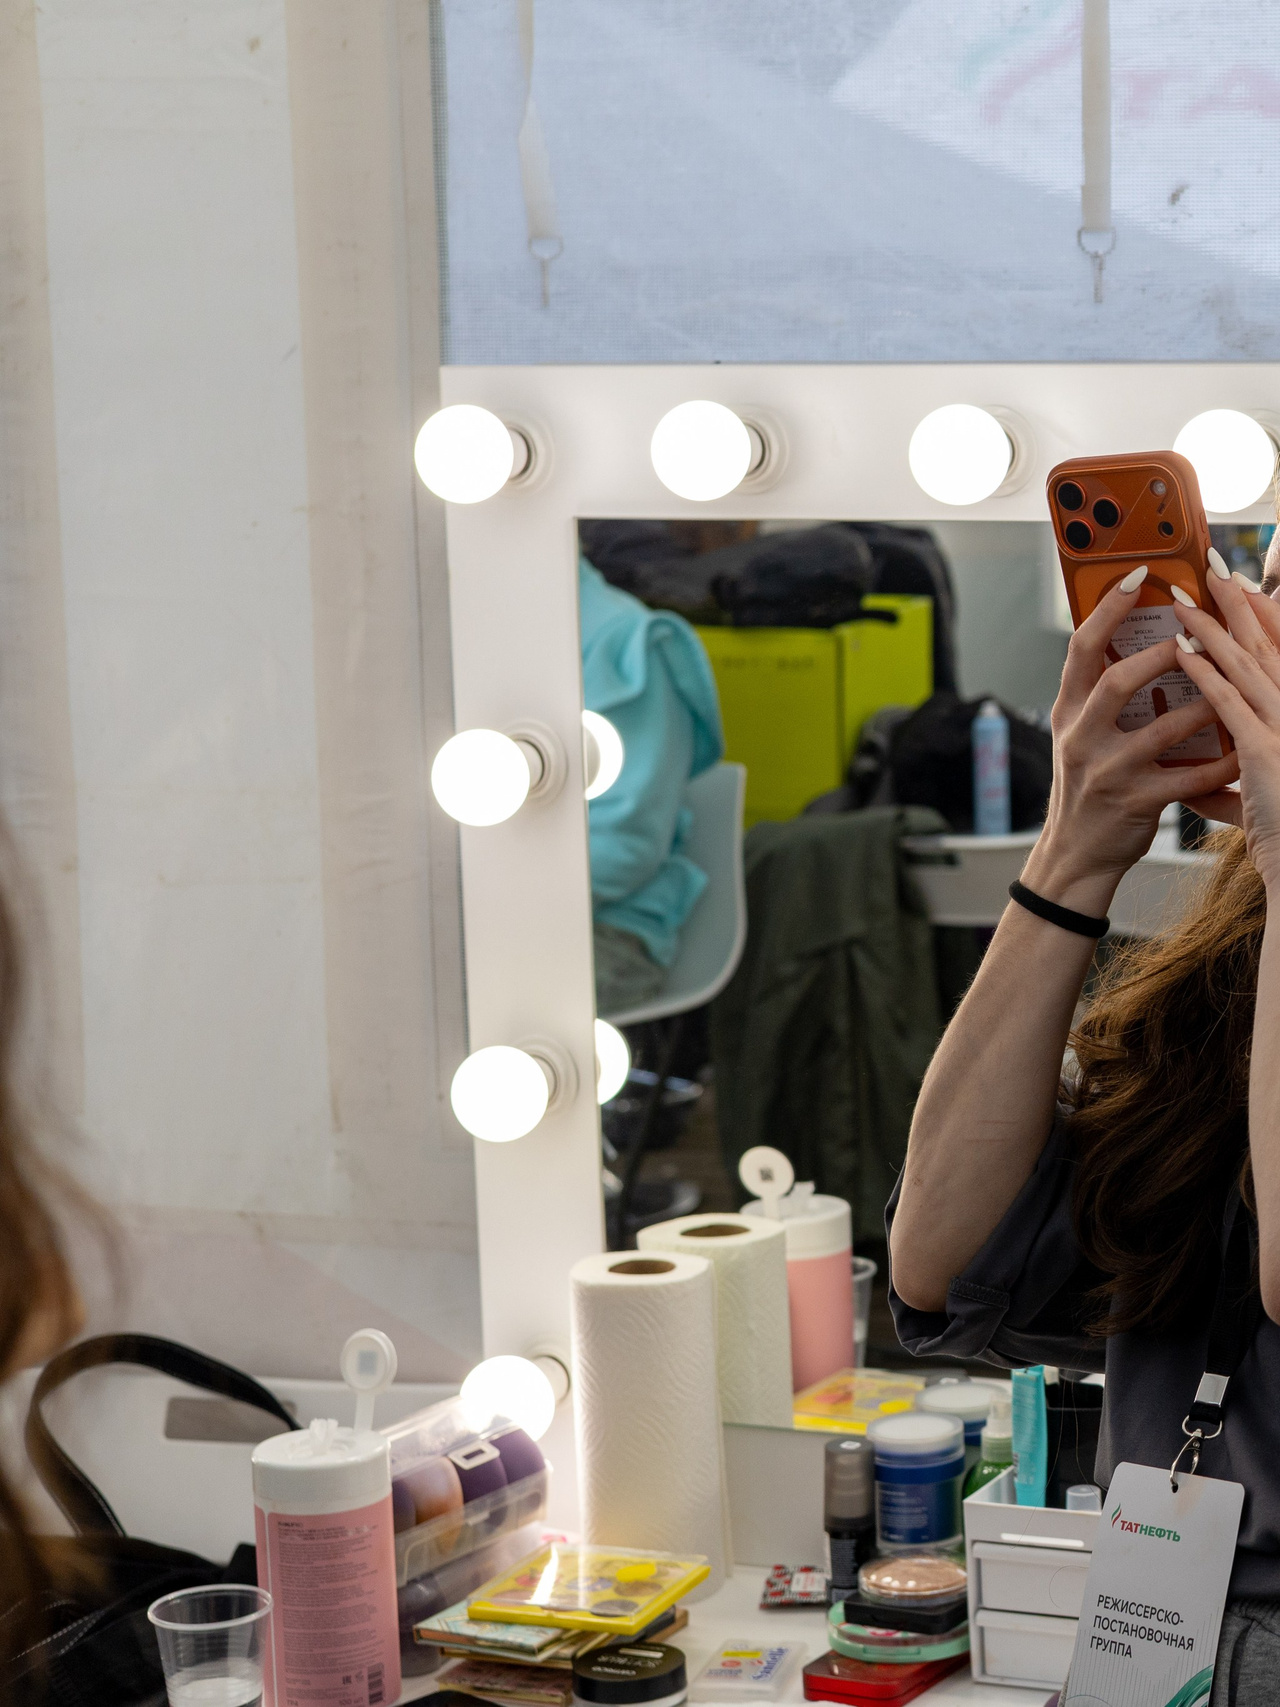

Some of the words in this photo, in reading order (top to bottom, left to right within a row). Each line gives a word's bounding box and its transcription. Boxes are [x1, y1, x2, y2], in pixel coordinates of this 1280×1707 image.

[1119, 1519, 1181, 1543] ТАТНЕФТЬ
[1096, 1593, 1184, 1626] РЕЖИССЕРСКО-
[1089, 1635, 1133, 1659] ГРУППА
[1092, 1614, 1195, 1652] ПОСТАНОВОЧНАЯ
